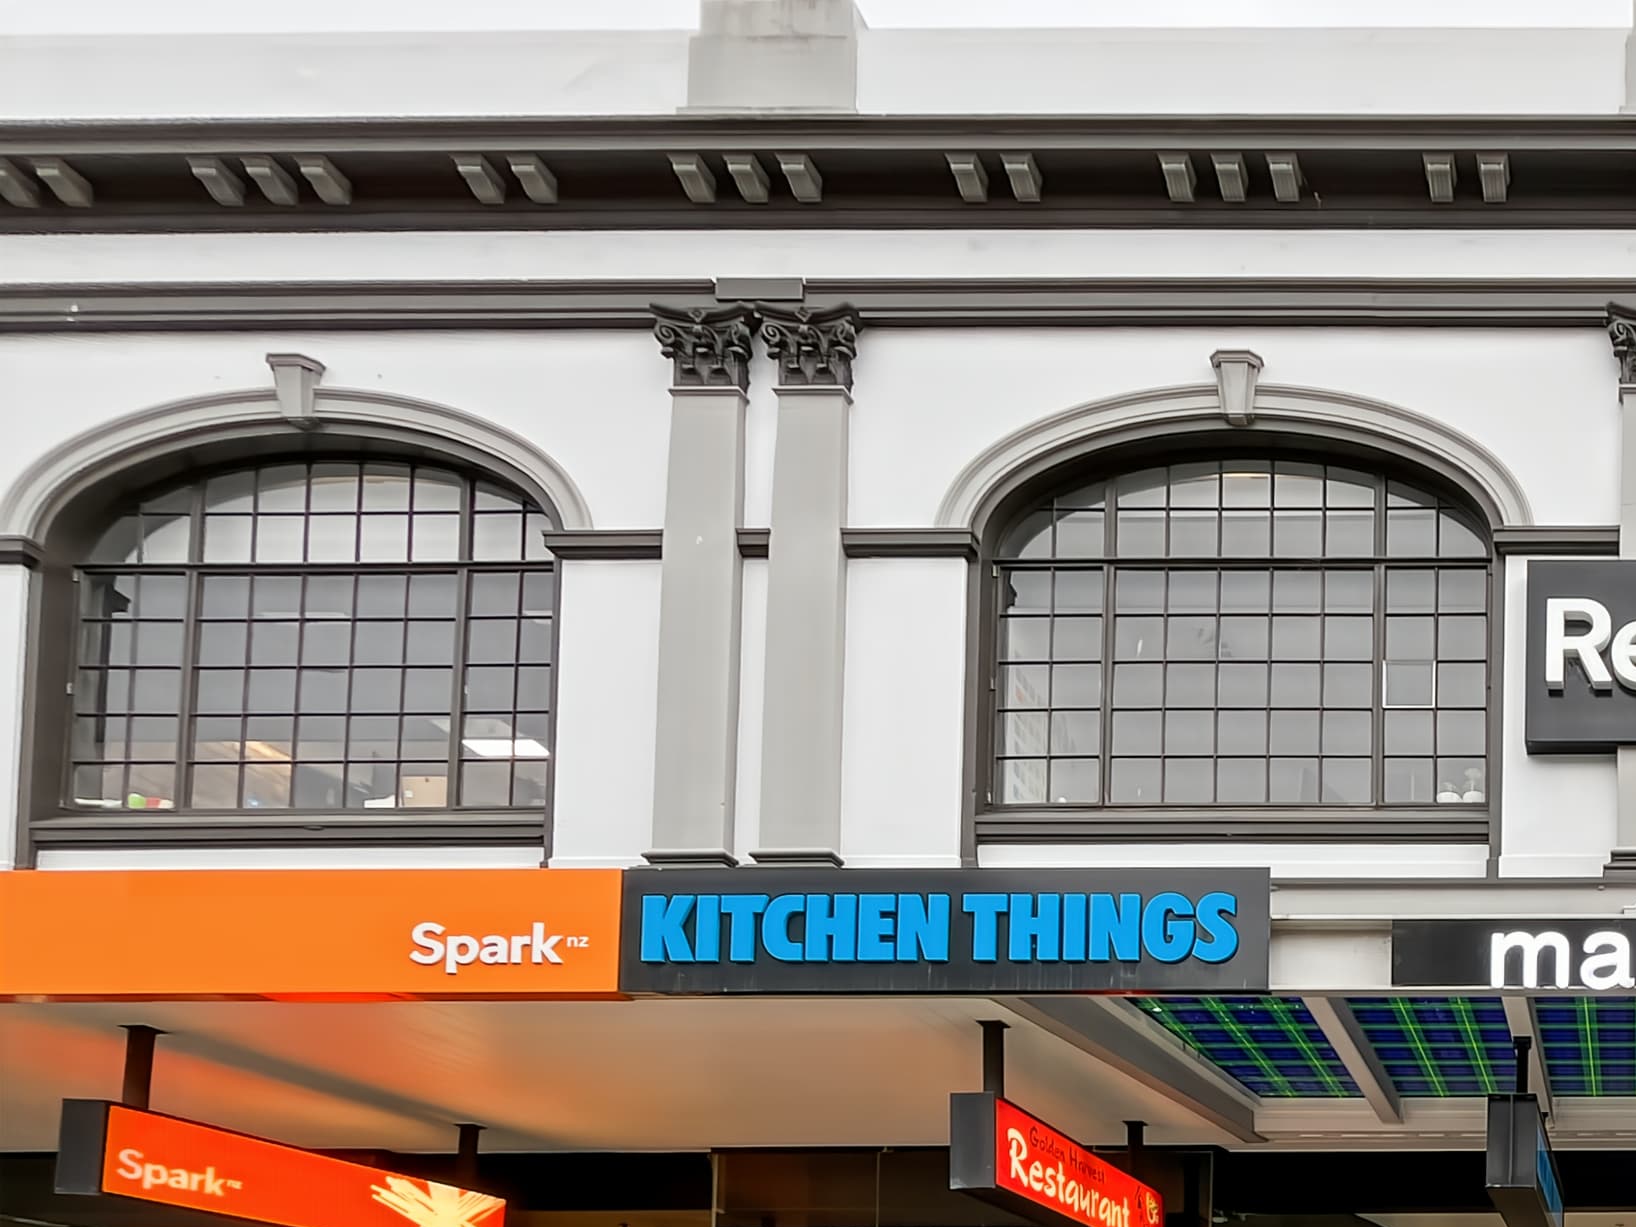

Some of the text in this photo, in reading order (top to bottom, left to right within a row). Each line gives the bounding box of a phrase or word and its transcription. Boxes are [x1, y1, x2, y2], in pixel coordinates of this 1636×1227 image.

[409, 922, 590, 974] Spark nz
[640, 891, 1239, 963] KITCHEN THINGS
[117, 1148, 225, 1196] Spark
